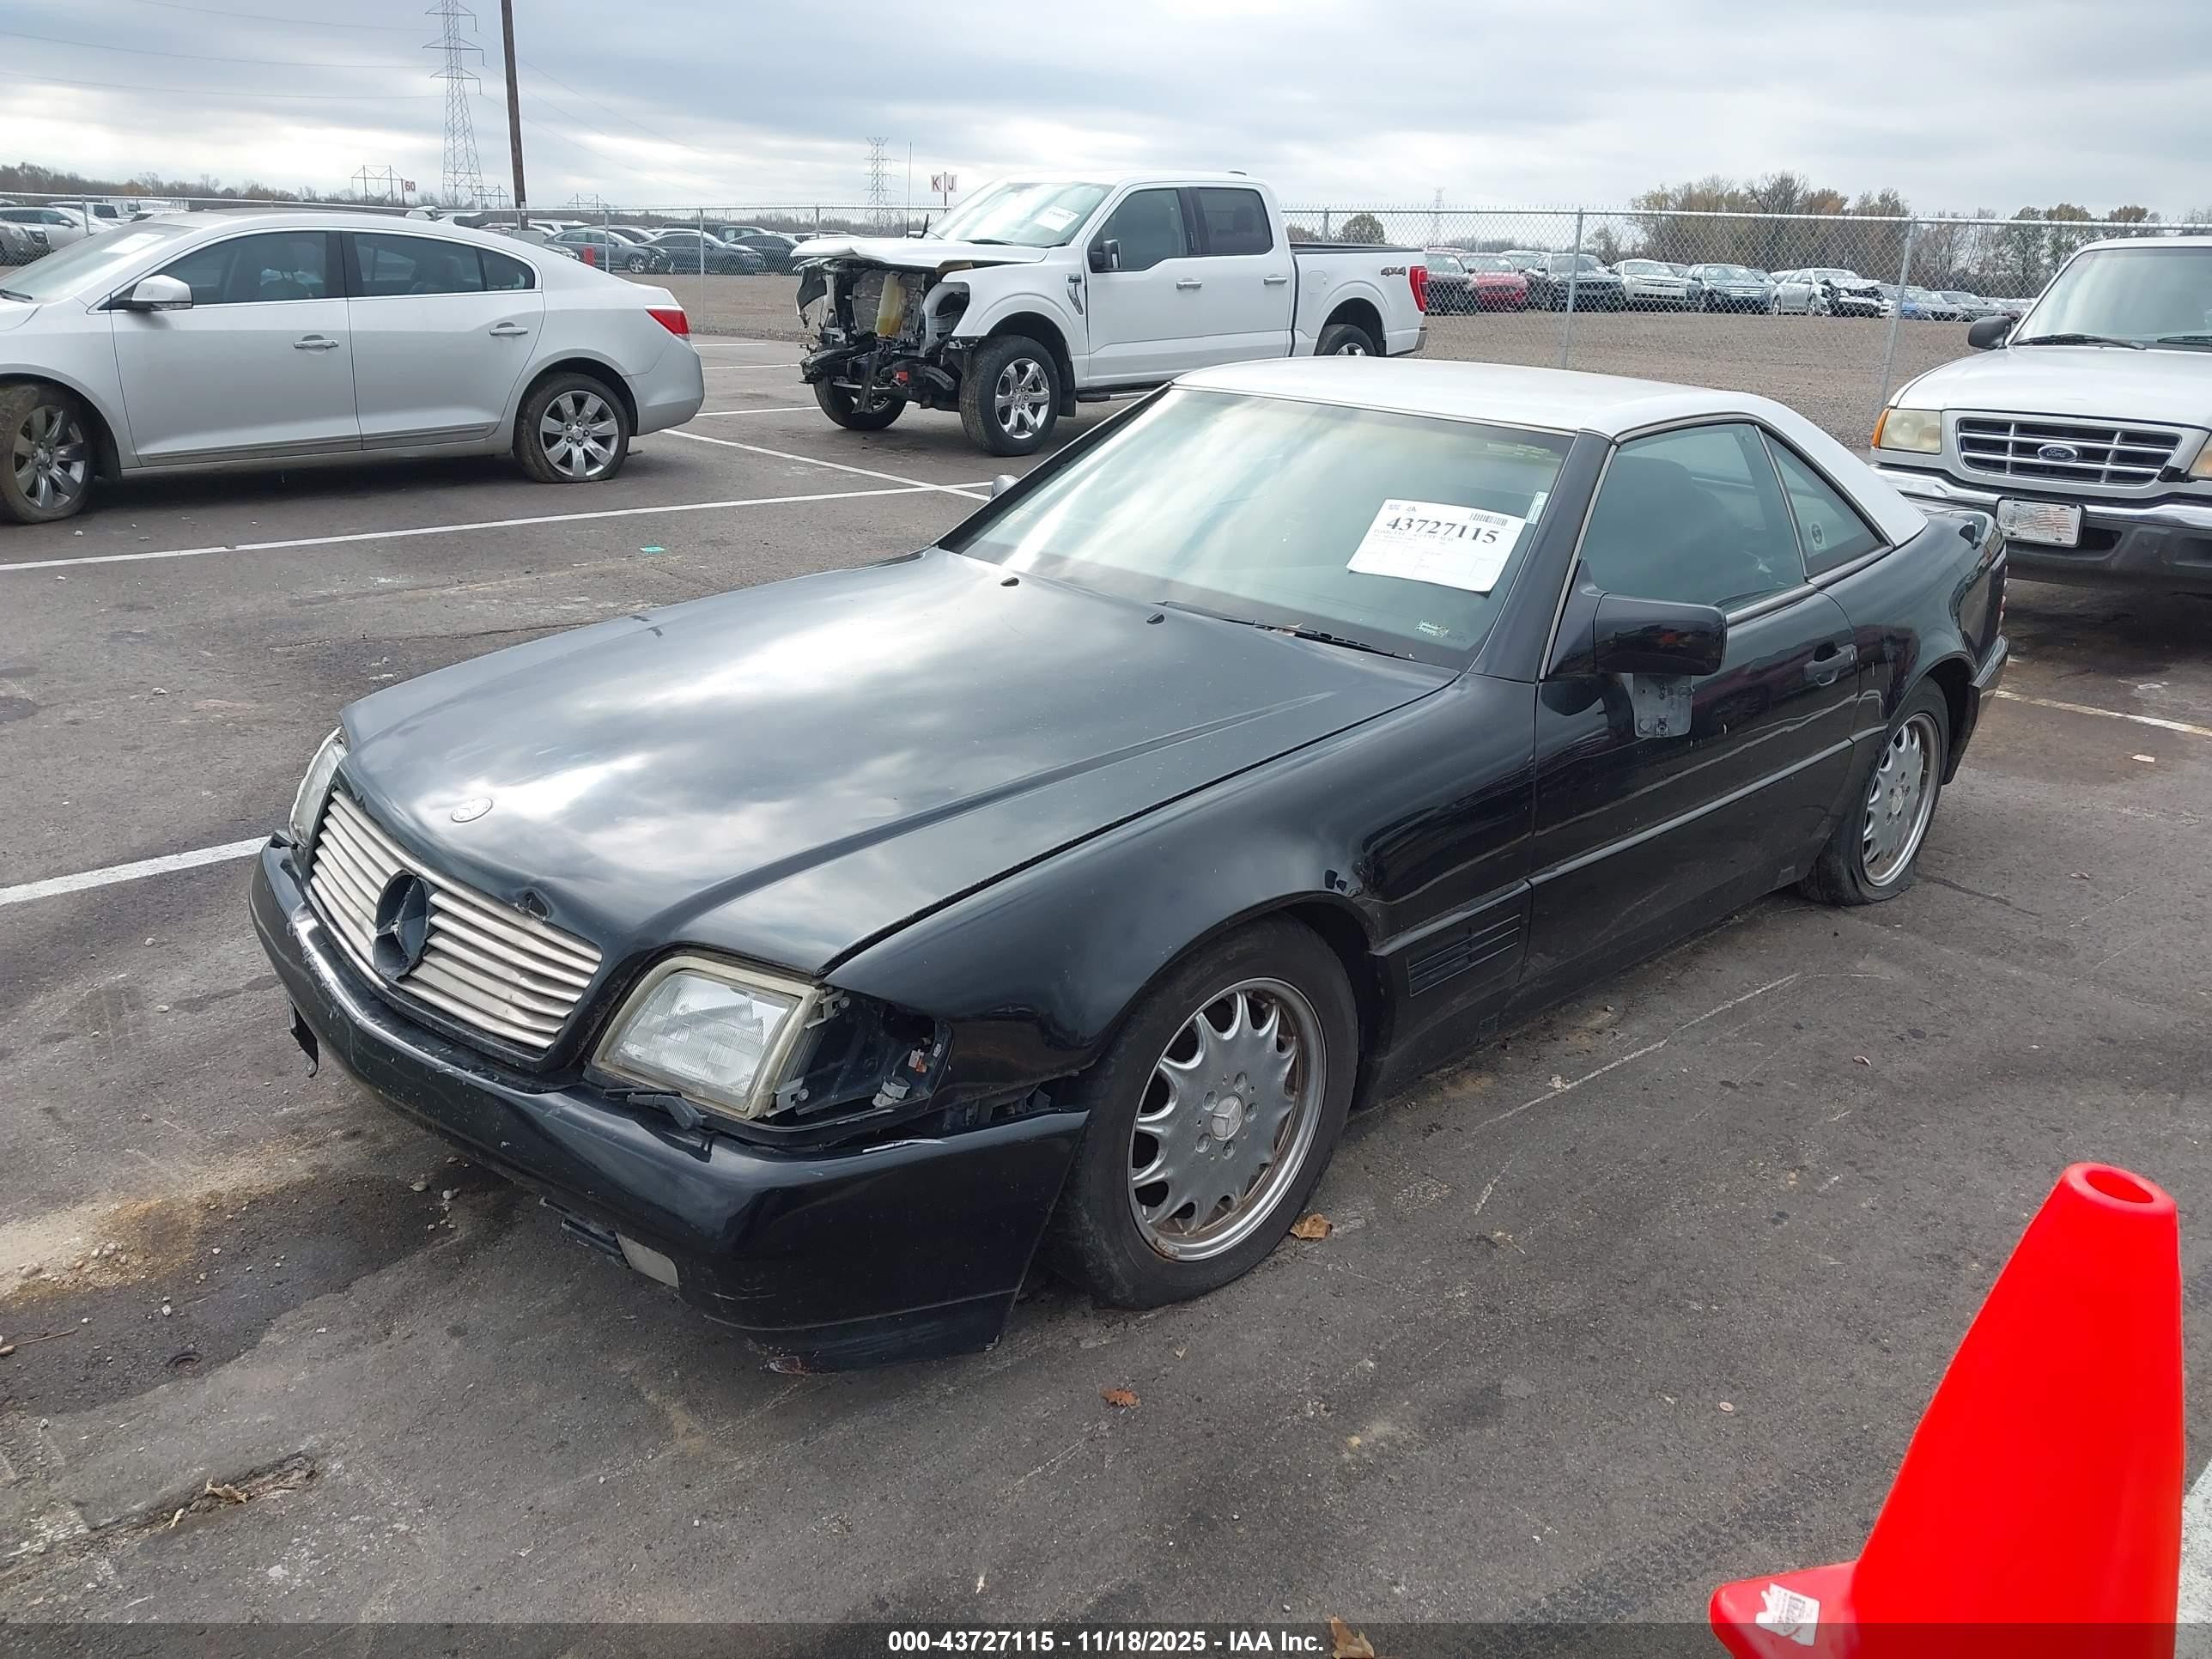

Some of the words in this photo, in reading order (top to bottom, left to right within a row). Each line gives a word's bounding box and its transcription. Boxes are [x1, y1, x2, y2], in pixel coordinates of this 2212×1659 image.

[404, 180, 416, 191] 60
[932, 176, 940, 191] K
[947, 176, 955, 191] J
[1386, 516, 1501, 544] 43727115
